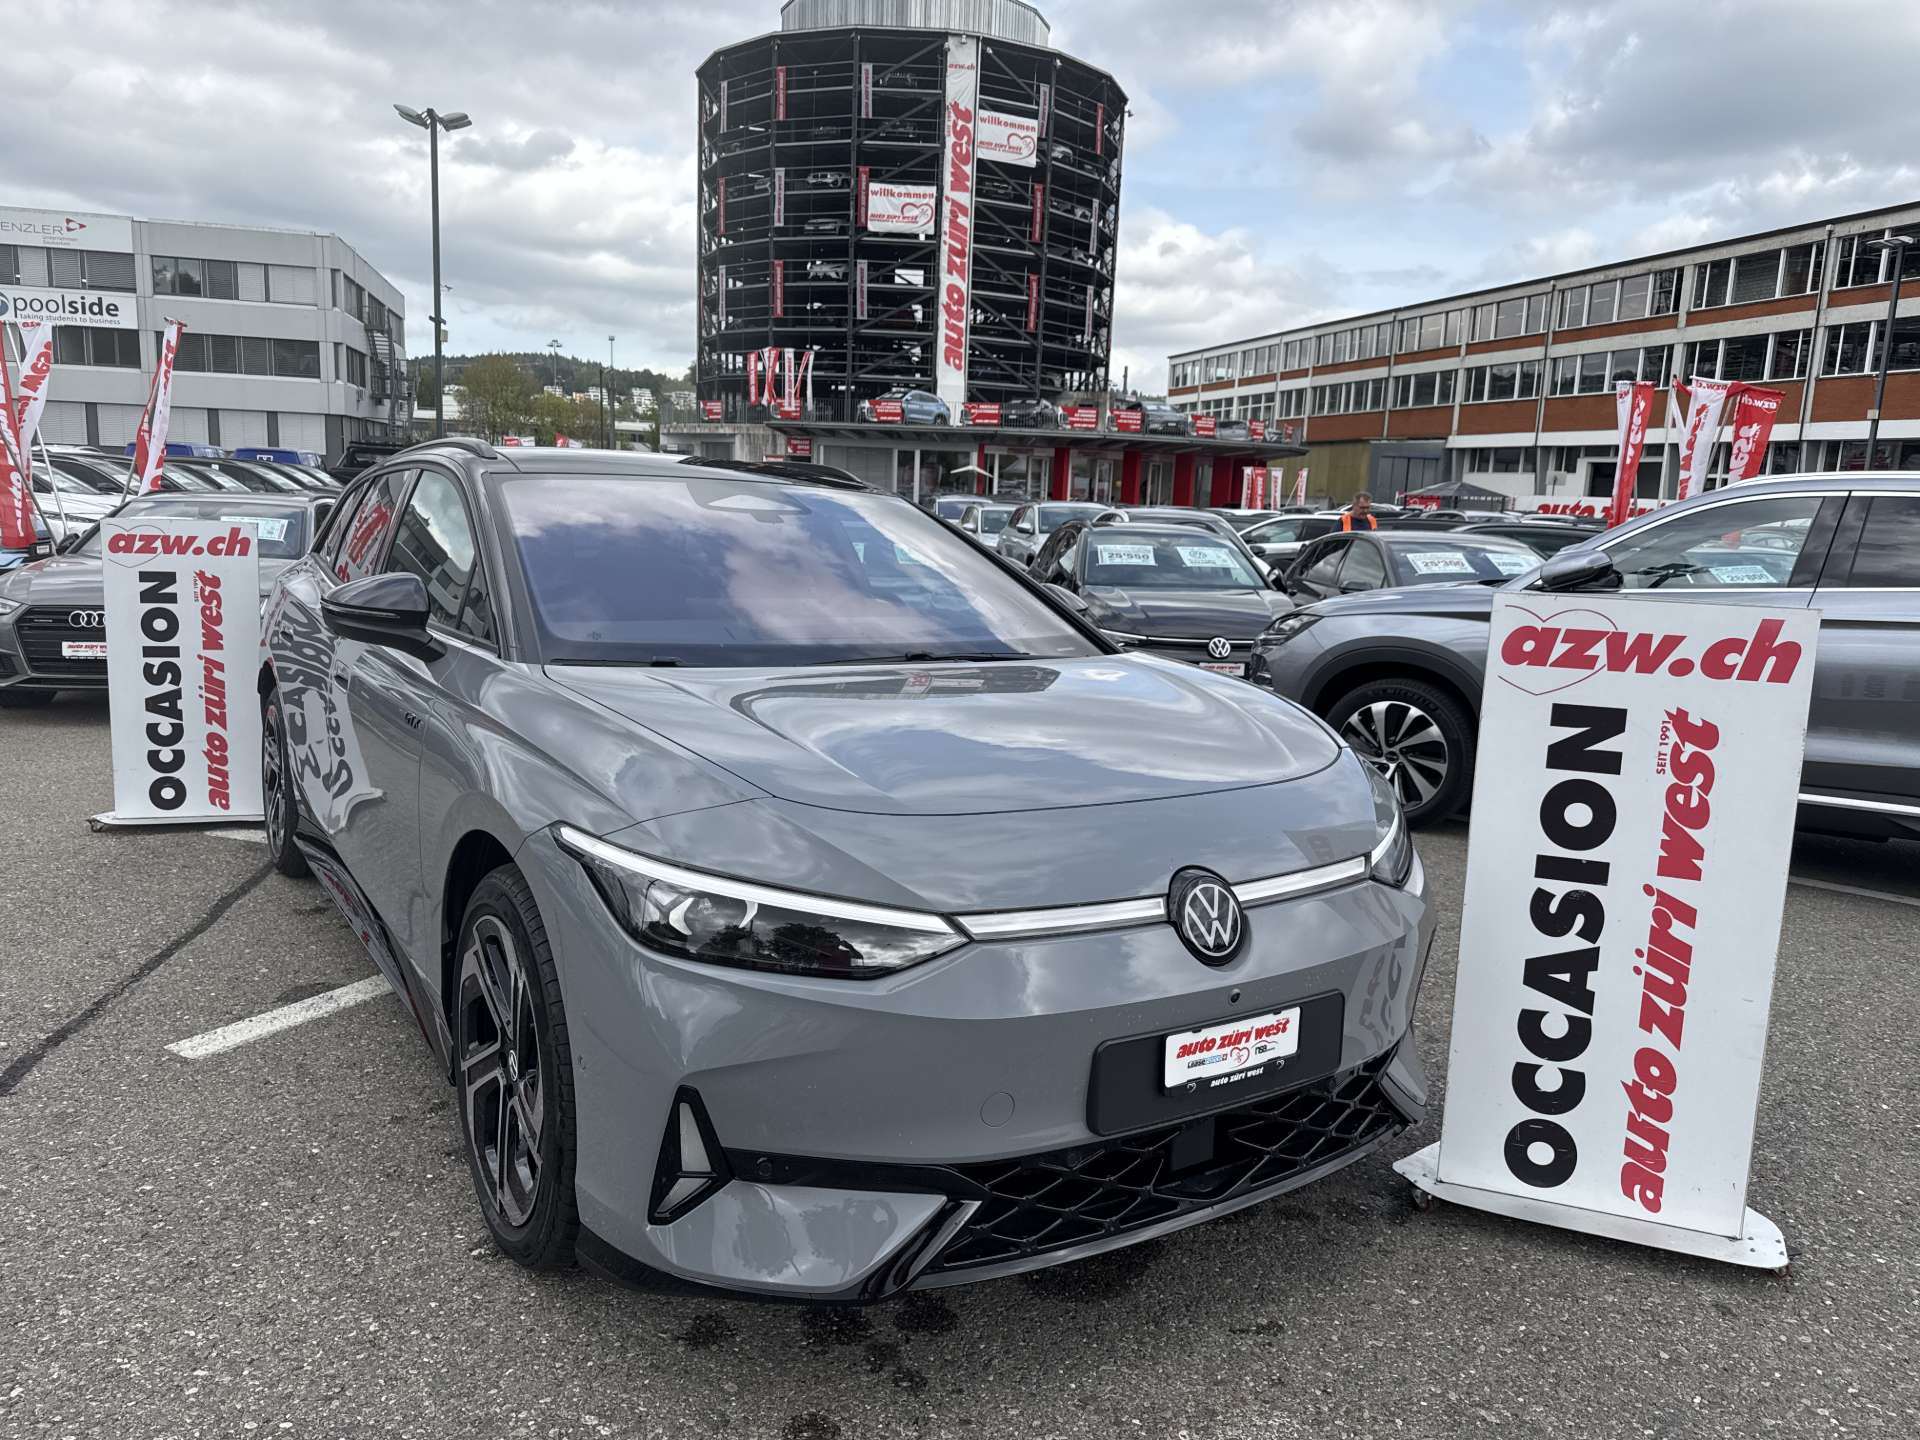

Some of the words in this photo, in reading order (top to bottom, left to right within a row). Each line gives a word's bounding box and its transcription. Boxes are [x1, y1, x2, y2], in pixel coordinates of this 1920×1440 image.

[949, 63, 976, 71] azw.ch
[949, 100, 973, 192] west
[979, 115, 1037, 133] willkommen
[870, 188, 935, 200] willkommen
[0, 221, 63, 236] ENZLER
[943, 195, 970, 282] züri
[13, 294, 119, 319] poolside
[46, 315, 78, 323] students
[90, 316, 121, 325] business
[943, 282, 967, 371] auto
[108, 527, 251, 557] azw.ch
[194, 569, 223, 651] west
[1500, 618, 1803, 684] azw.ch
[138, 571, 187, 811] OCCASION
[197, 654, 228, 731] züri
[1656, 745, 1667, 775] SEIT
[1658, 720, 1669, 744] 1991
[202, 731, 230, 811] auto
[1656, 707, 1721, 881] west
[1504, 702, 1629, 1188] OCCASION
[1632, 884, 1698, 1051] züri
[1176, 1037, 1217, 1059] auto
[1217, 1026, 1254, 1050] züri
[1254, 1018, 1290, 1041] west
[1210, 1076, 1229, 1088] auto
[1229, 1071, 1246, 1083] züri
[1247, 1066, 1264, 1078] west
[1620, 1050, 1677, 1213] auto
